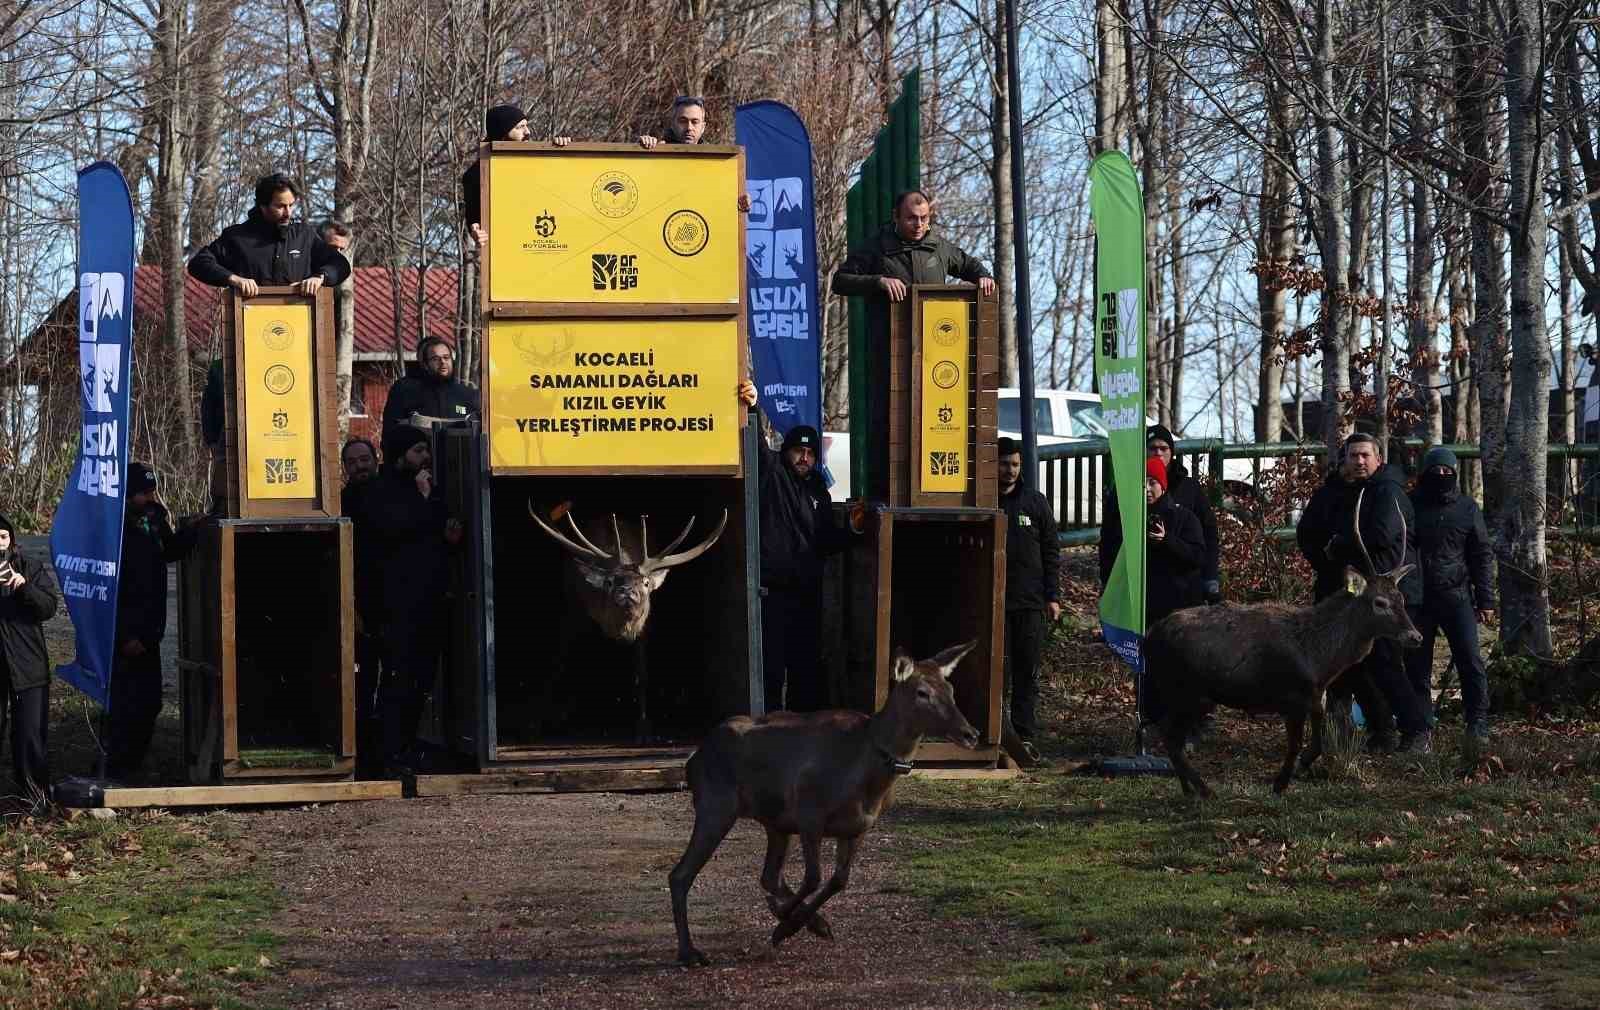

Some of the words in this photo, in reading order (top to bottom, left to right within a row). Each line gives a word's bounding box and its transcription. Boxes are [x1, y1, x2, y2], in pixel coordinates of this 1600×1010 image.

[575, 348, 654, 367] KOCAELİ
[529, 374, 615, 389] SAMANLI
[618, 370, 698, 388] DAĞLARI
[563, 396, 608, 410] KIZIL
[612, 392, 666, 410] GEYİK
[516, 414, 636, 437] YERLEŞTİRME
[639, 413, 714, 432] PROJESİ
